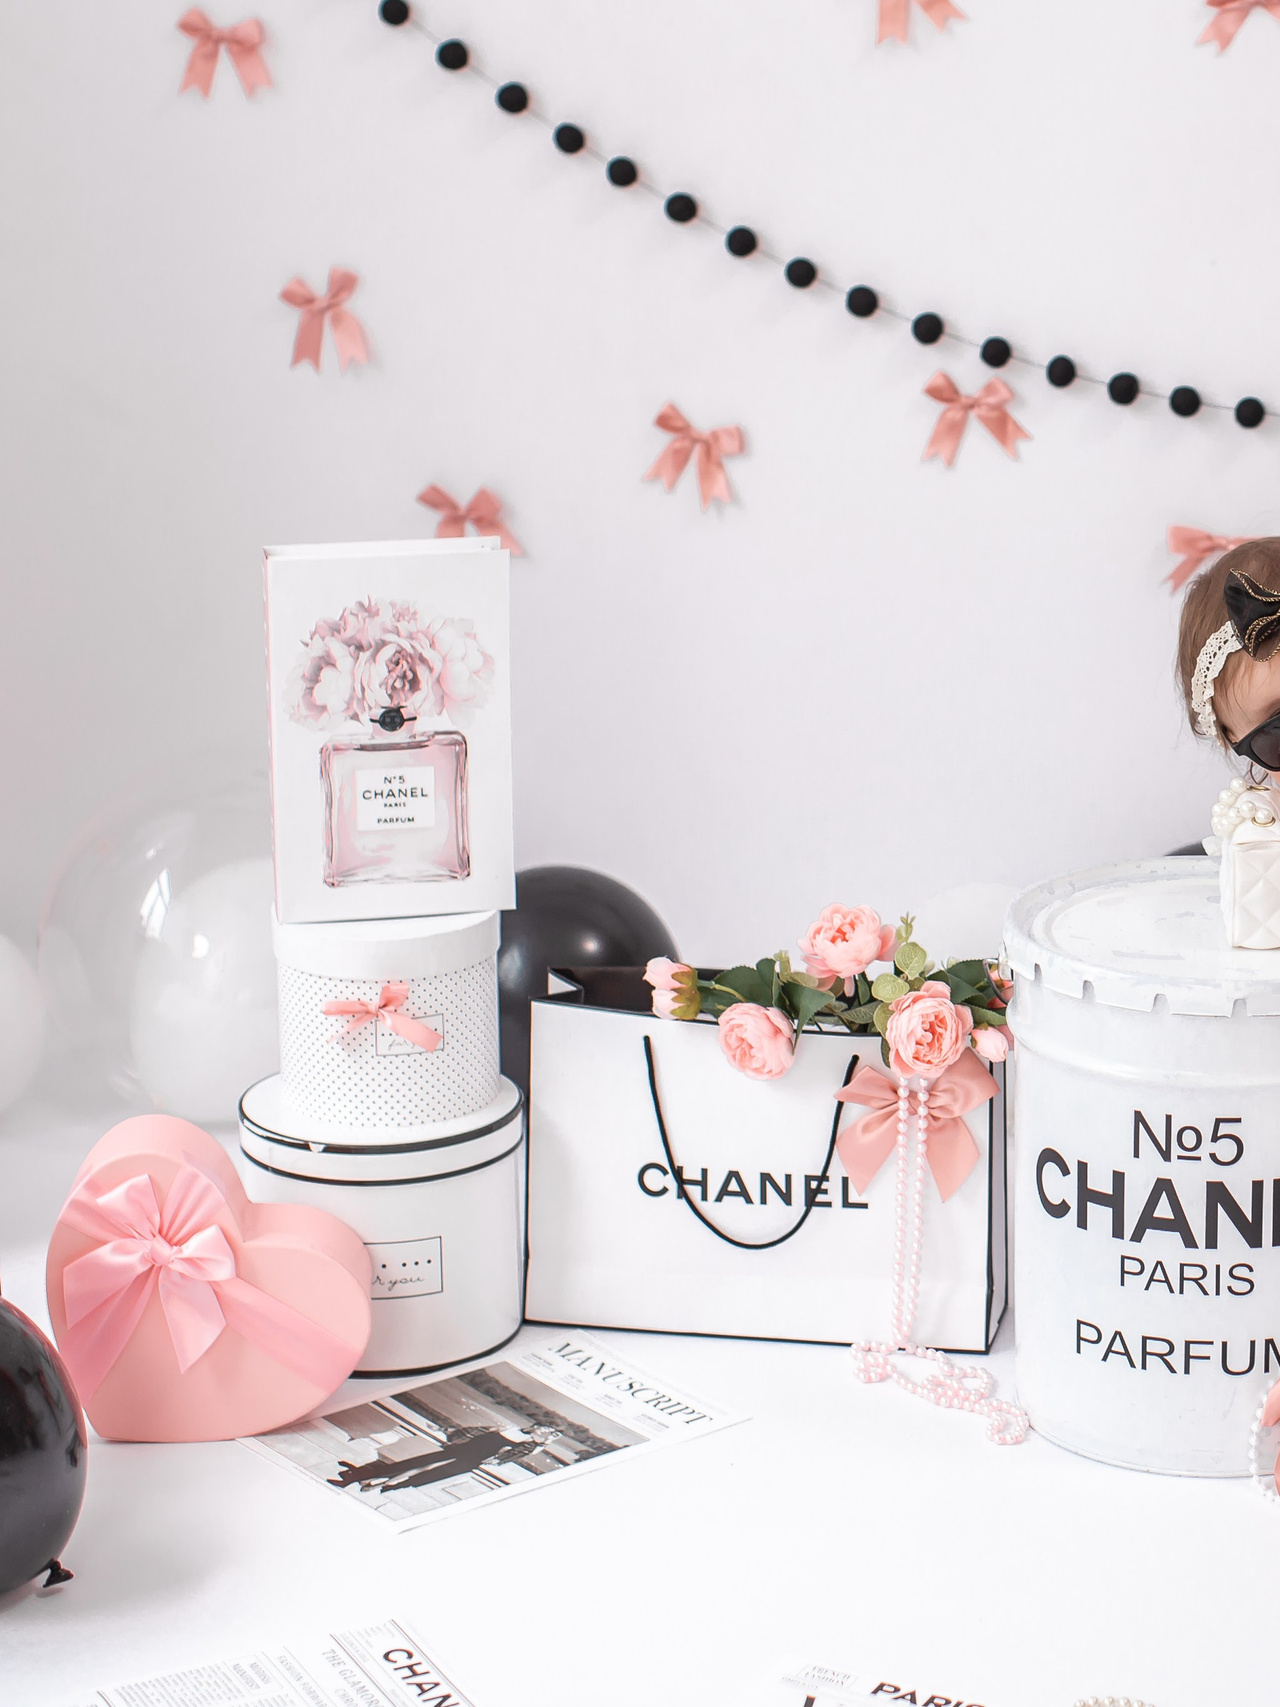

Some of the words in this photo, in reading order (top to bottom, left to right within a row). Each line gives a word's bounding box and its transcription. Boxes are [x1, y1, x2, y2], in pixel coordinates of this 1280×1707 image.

[362, 787, 428, 801] CHANEL
[637, 1162, 869, 1210] CHANEL
[1119, 1254, 1255, 1297] PARIS
[548, 1341, 714, 1425] MANUSCRIPT
